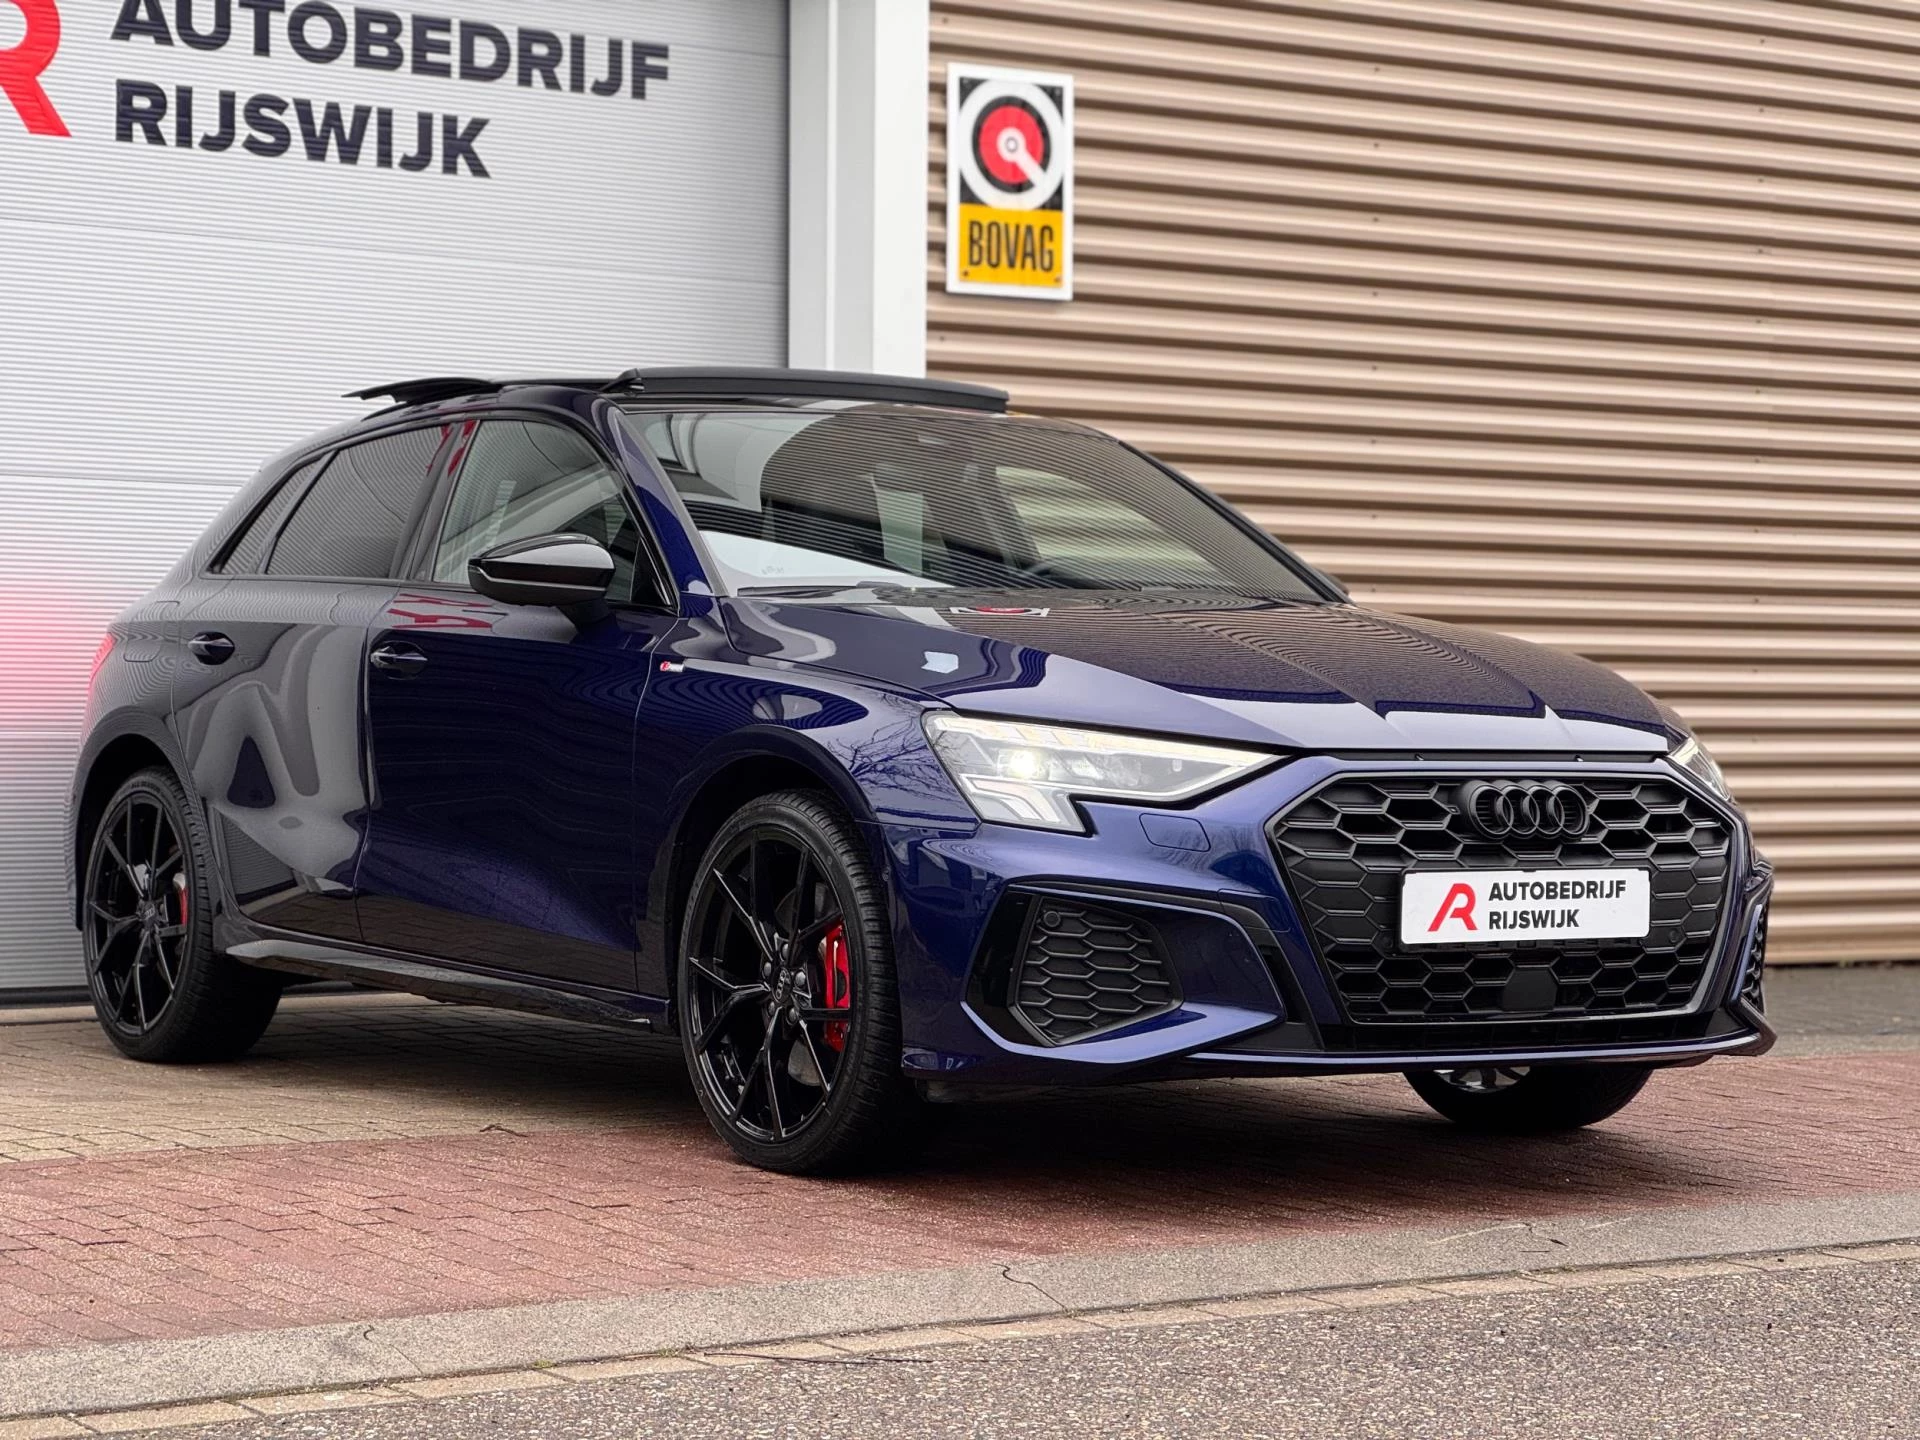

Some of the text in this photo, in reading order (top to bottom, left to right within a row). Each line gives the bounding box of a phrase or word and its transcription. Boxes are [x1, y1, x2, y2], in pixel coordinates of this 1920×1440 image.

[110, 0, 669, 100] AUTOBEDRIJF
[114, 78, 491, 178] RIJSWIJK
[968, 220, 1054, 273] BOVAG
[1488, 880, 1627, 901] AUTOBEDRIJF
[1488, 909, 1580, 930] RIJSWIJK
